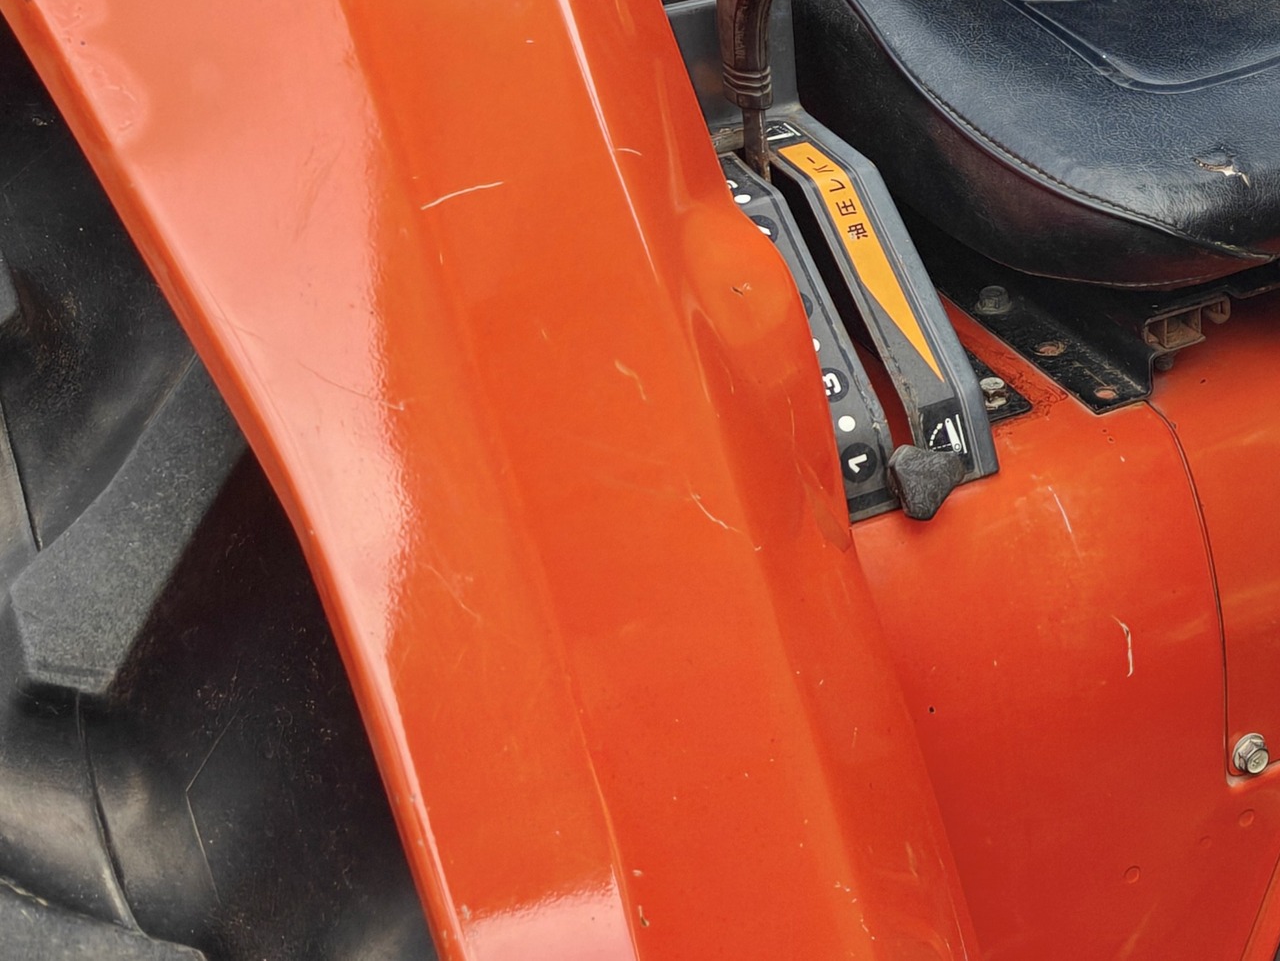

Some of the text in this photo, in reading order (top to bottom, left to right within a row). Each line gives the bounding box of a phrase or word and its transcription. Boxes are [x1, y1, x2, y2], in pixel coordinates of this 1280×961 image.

[806, 156, 868, 240] 油圧レバー
[822, 372, 842, 396] 3
[848, 453, 868, 473] 1
